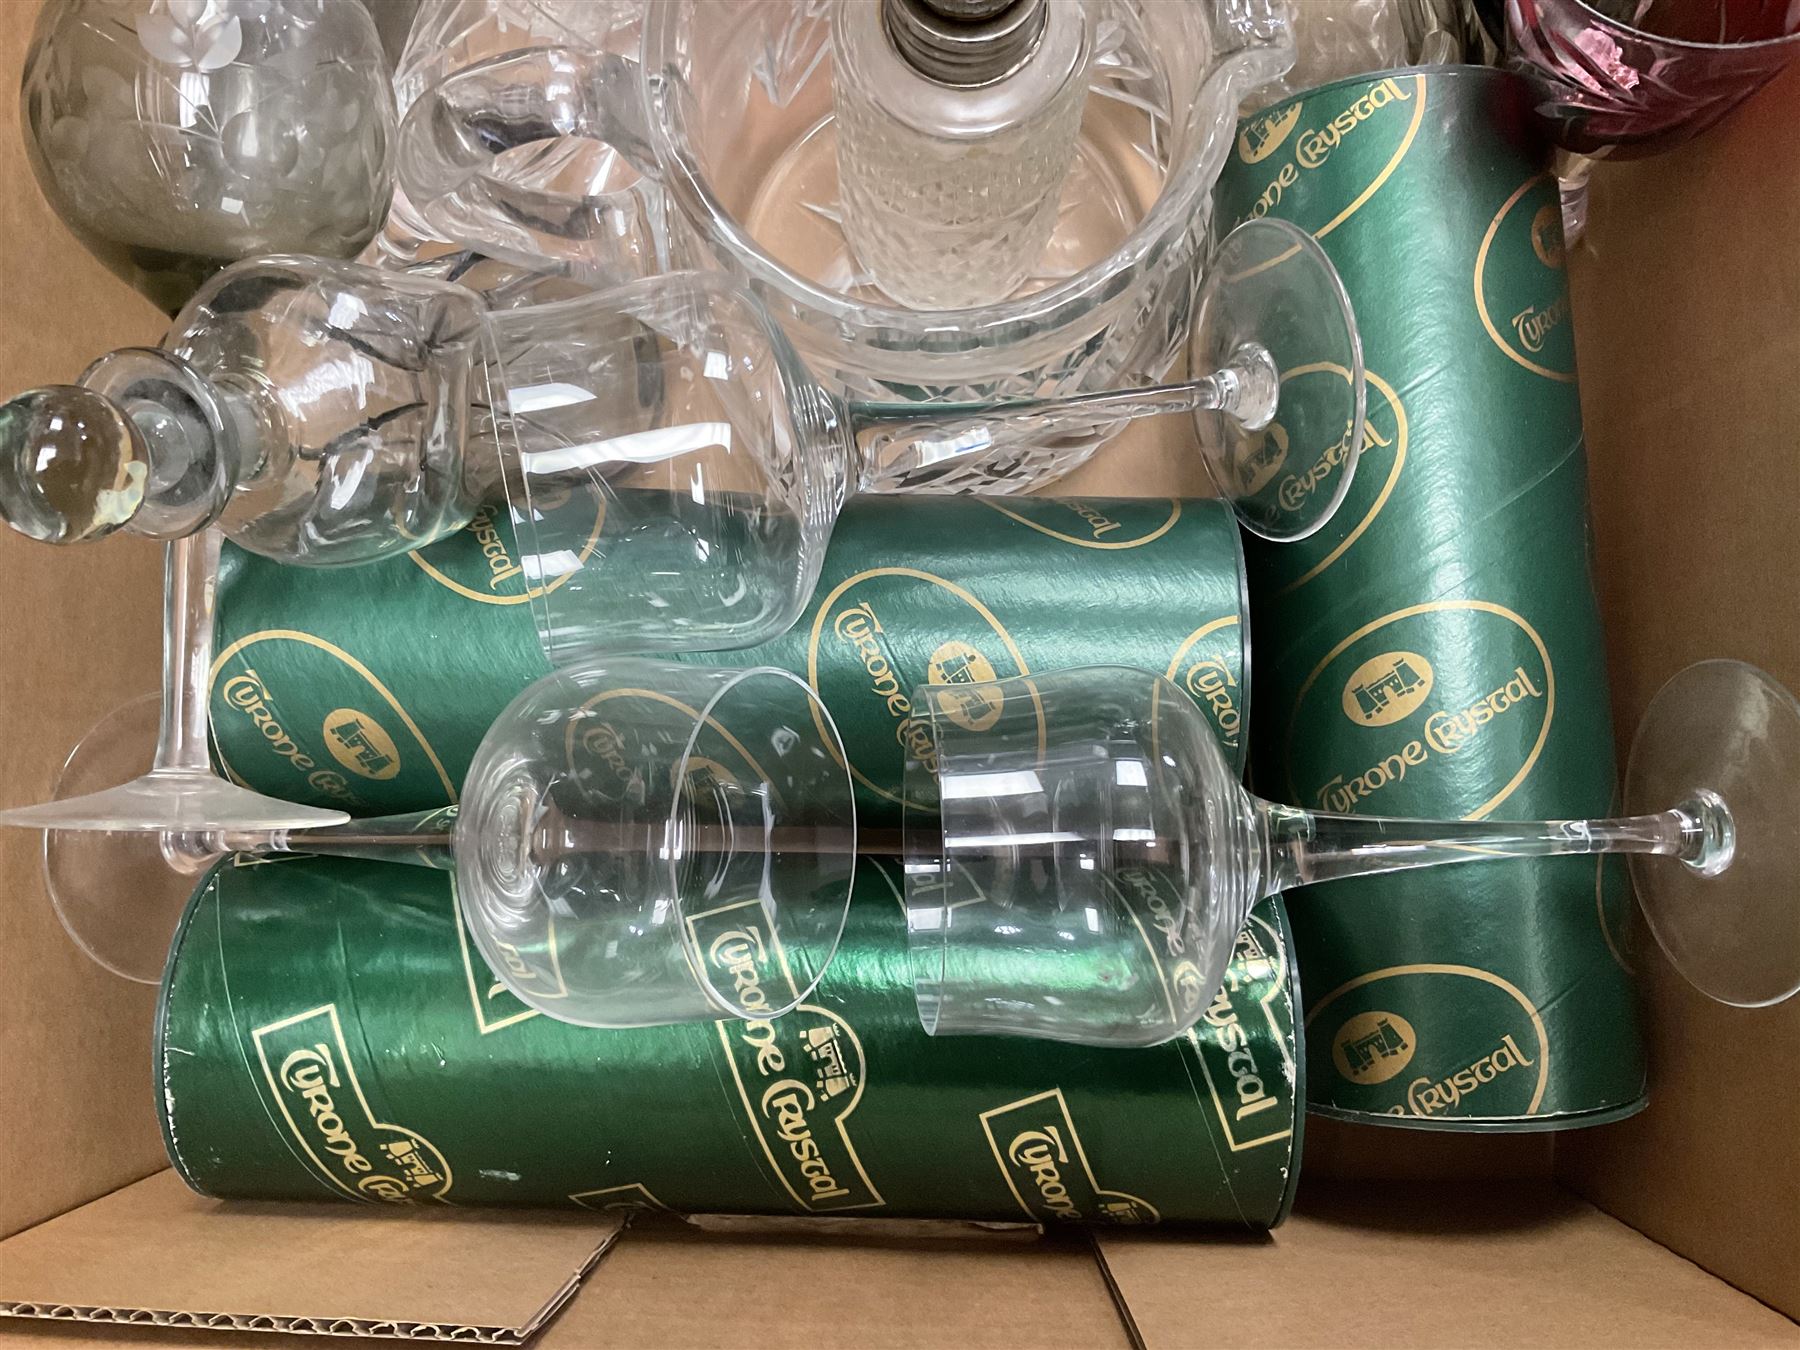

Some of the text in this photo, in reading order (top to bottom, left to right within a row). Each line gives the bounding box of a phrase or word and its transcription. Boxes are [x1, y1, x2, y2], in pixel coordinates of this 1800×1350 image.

[1296, 78, 1411, 169] Crystal
[1279, 419, 1392, 512] Crystal
[834, 602, 911, 717] Tyrone
[223, 669, 315, 771] Tyrone
[1317, 667, 1543, 813] Tyrone Crystal
[280, 1044, 372, 1174] Tyrone
[710, 926, 850, 1201] Tyrone Crystal
[1407, 1034, 1535, 1117] Crystal
[1009, 1125, 1082, 1219] Tyrone
